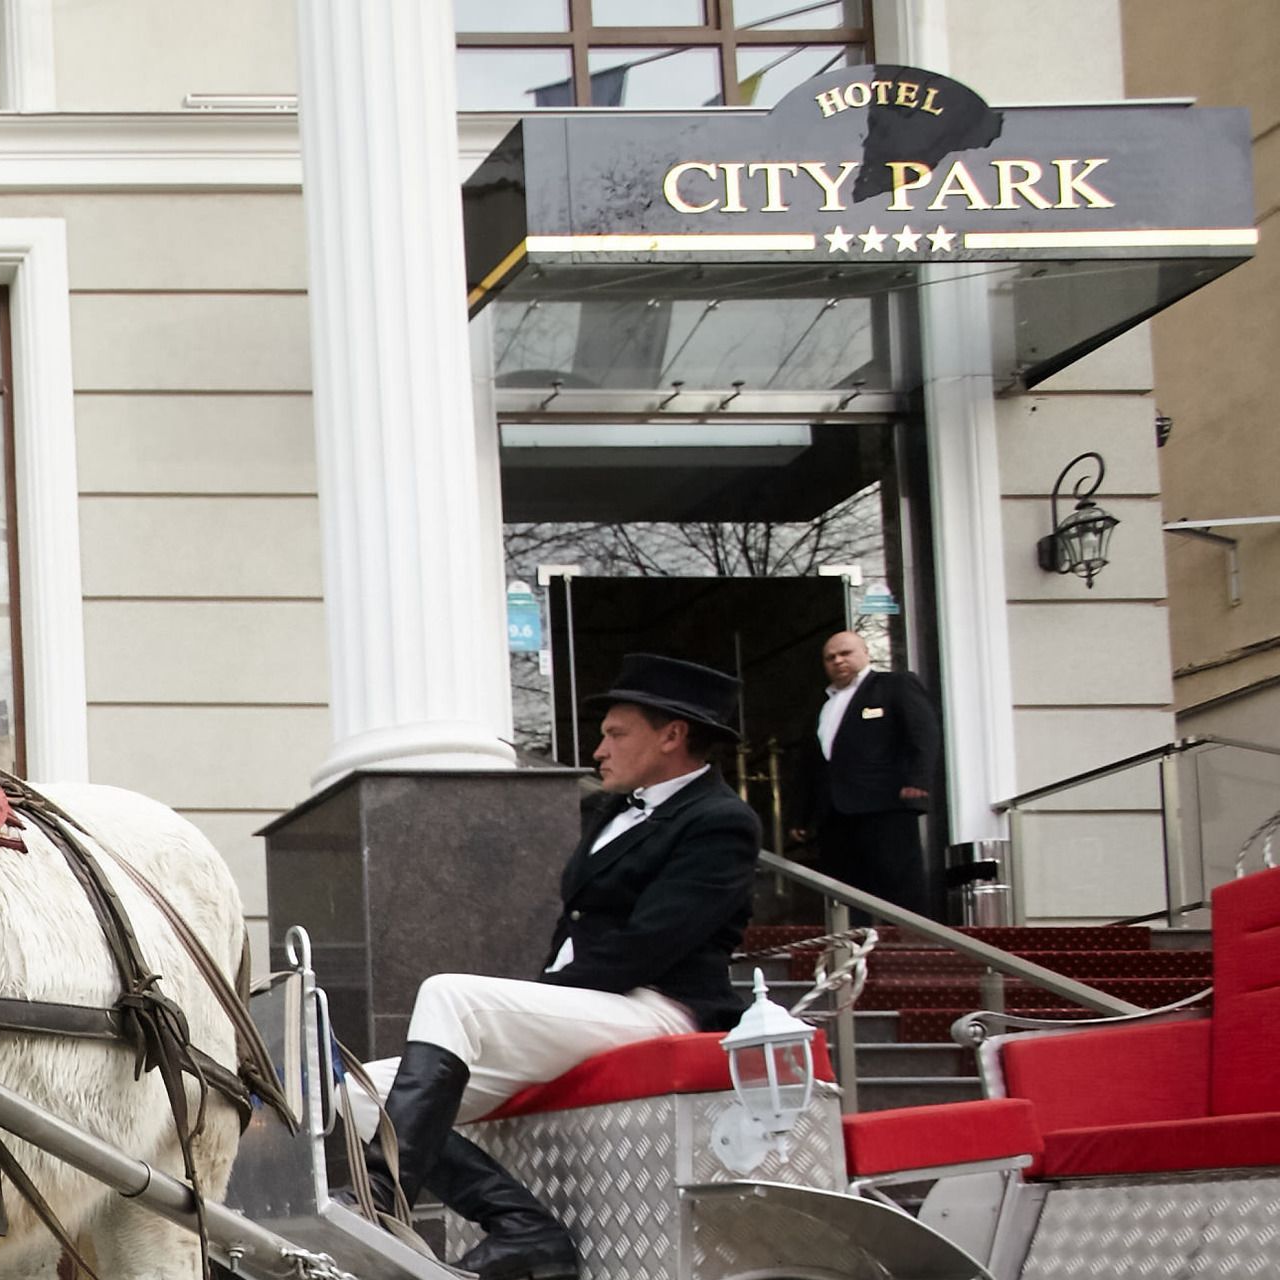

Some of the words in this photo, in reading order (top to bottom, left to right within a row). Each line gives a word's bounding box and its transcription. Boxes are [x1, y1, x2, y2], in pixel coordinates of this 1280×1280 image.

[814, 79, 944, 119] HOTEL
[662, 160, 859, 215] CITY
[885, 157, 1117, 212] PARK
